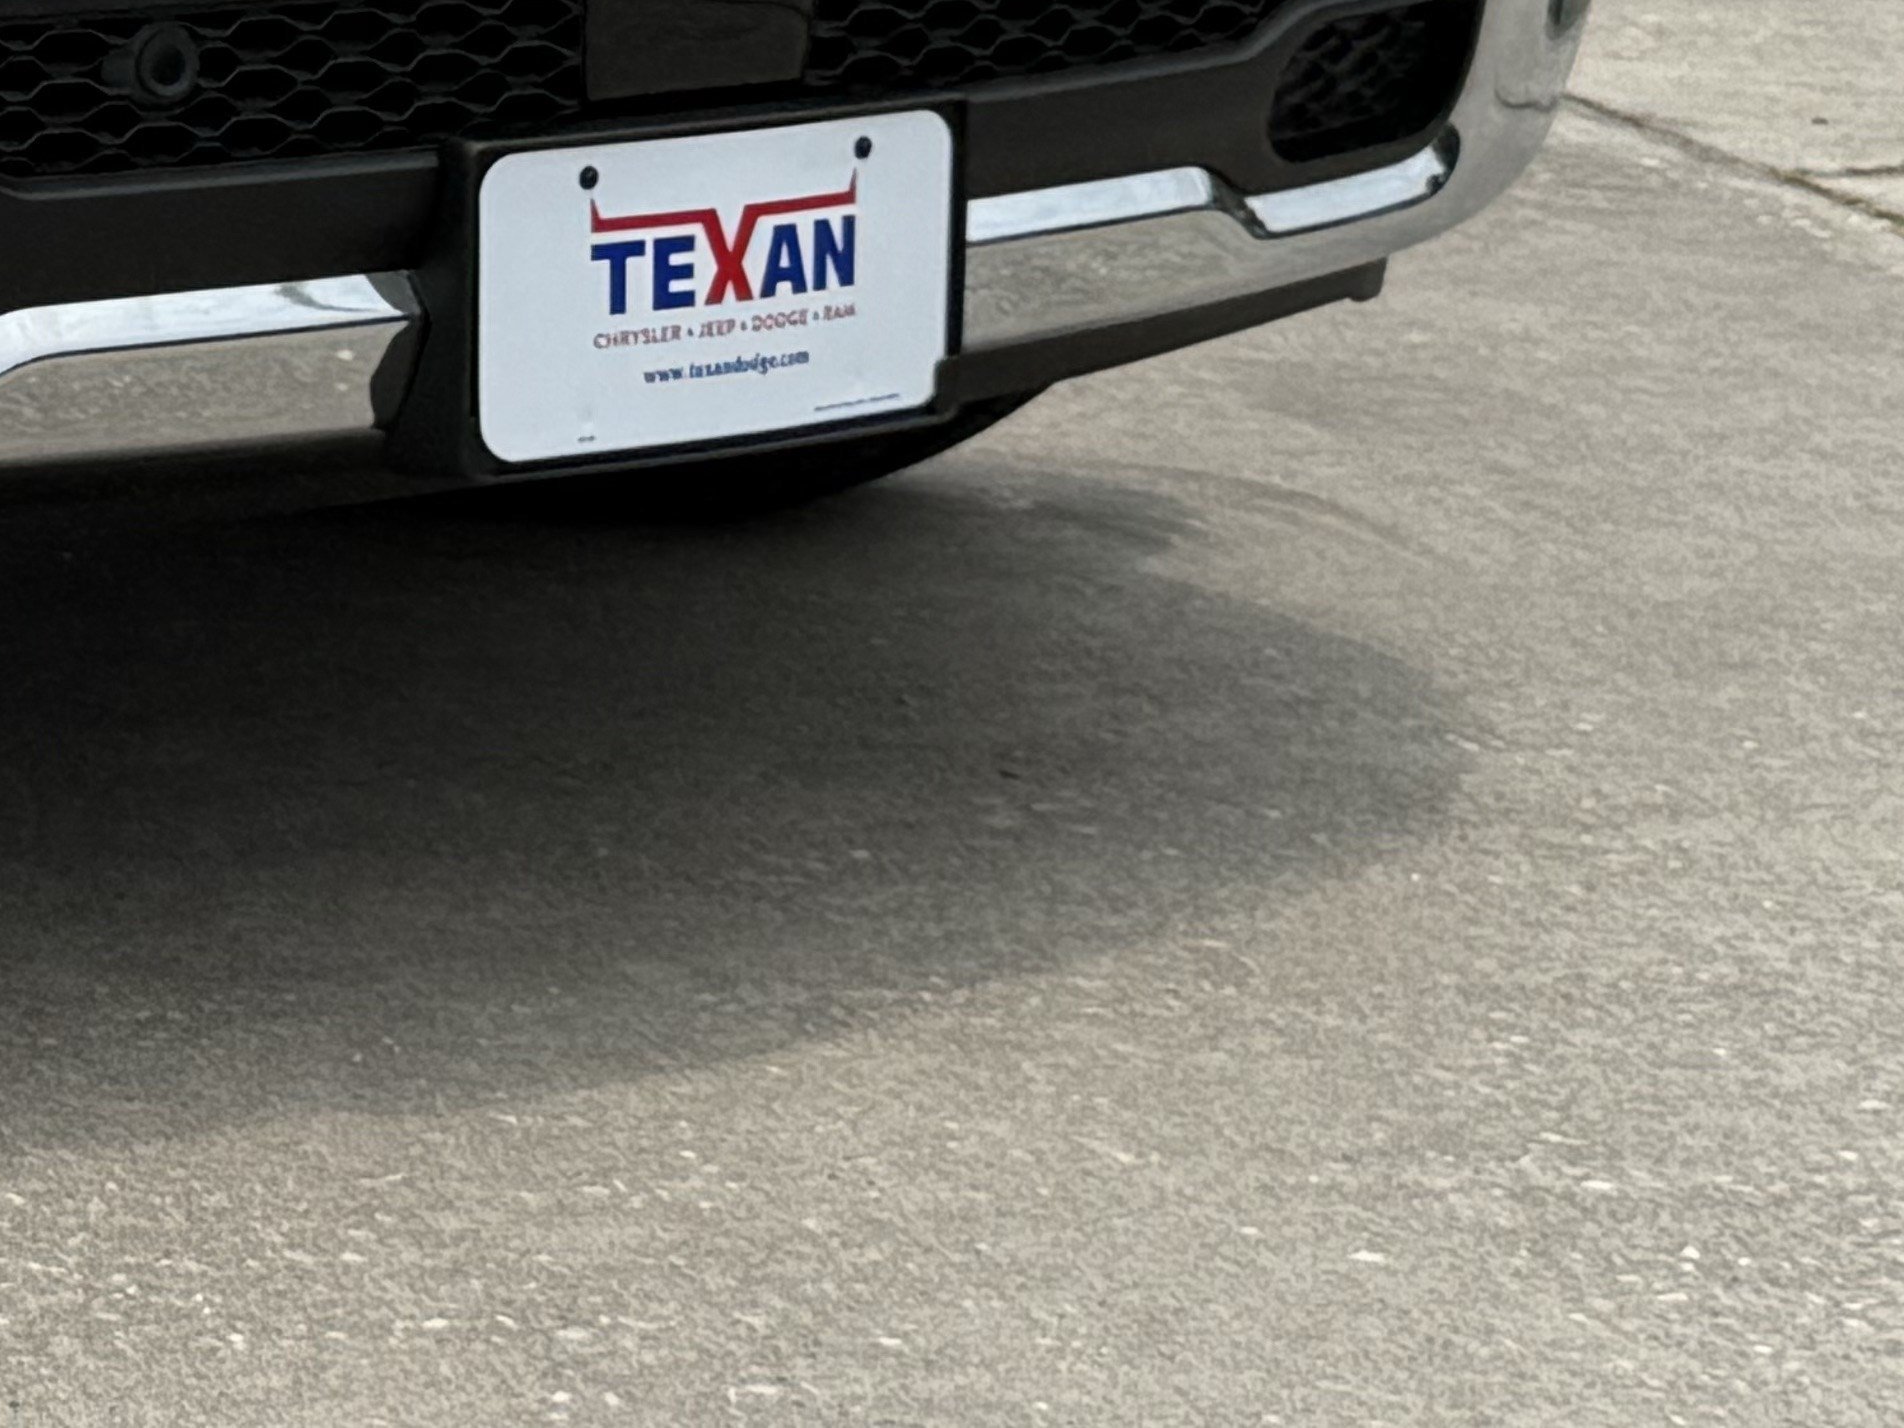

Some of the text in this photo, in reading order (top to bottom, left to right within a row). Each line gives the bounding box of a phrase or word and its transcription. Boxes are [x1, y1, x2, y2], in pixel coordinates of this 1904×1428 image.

[589, 194, 856, 315] TEXAN
[593, 302, 857, 350] CHRYSLER JEEP DODGE RAM
